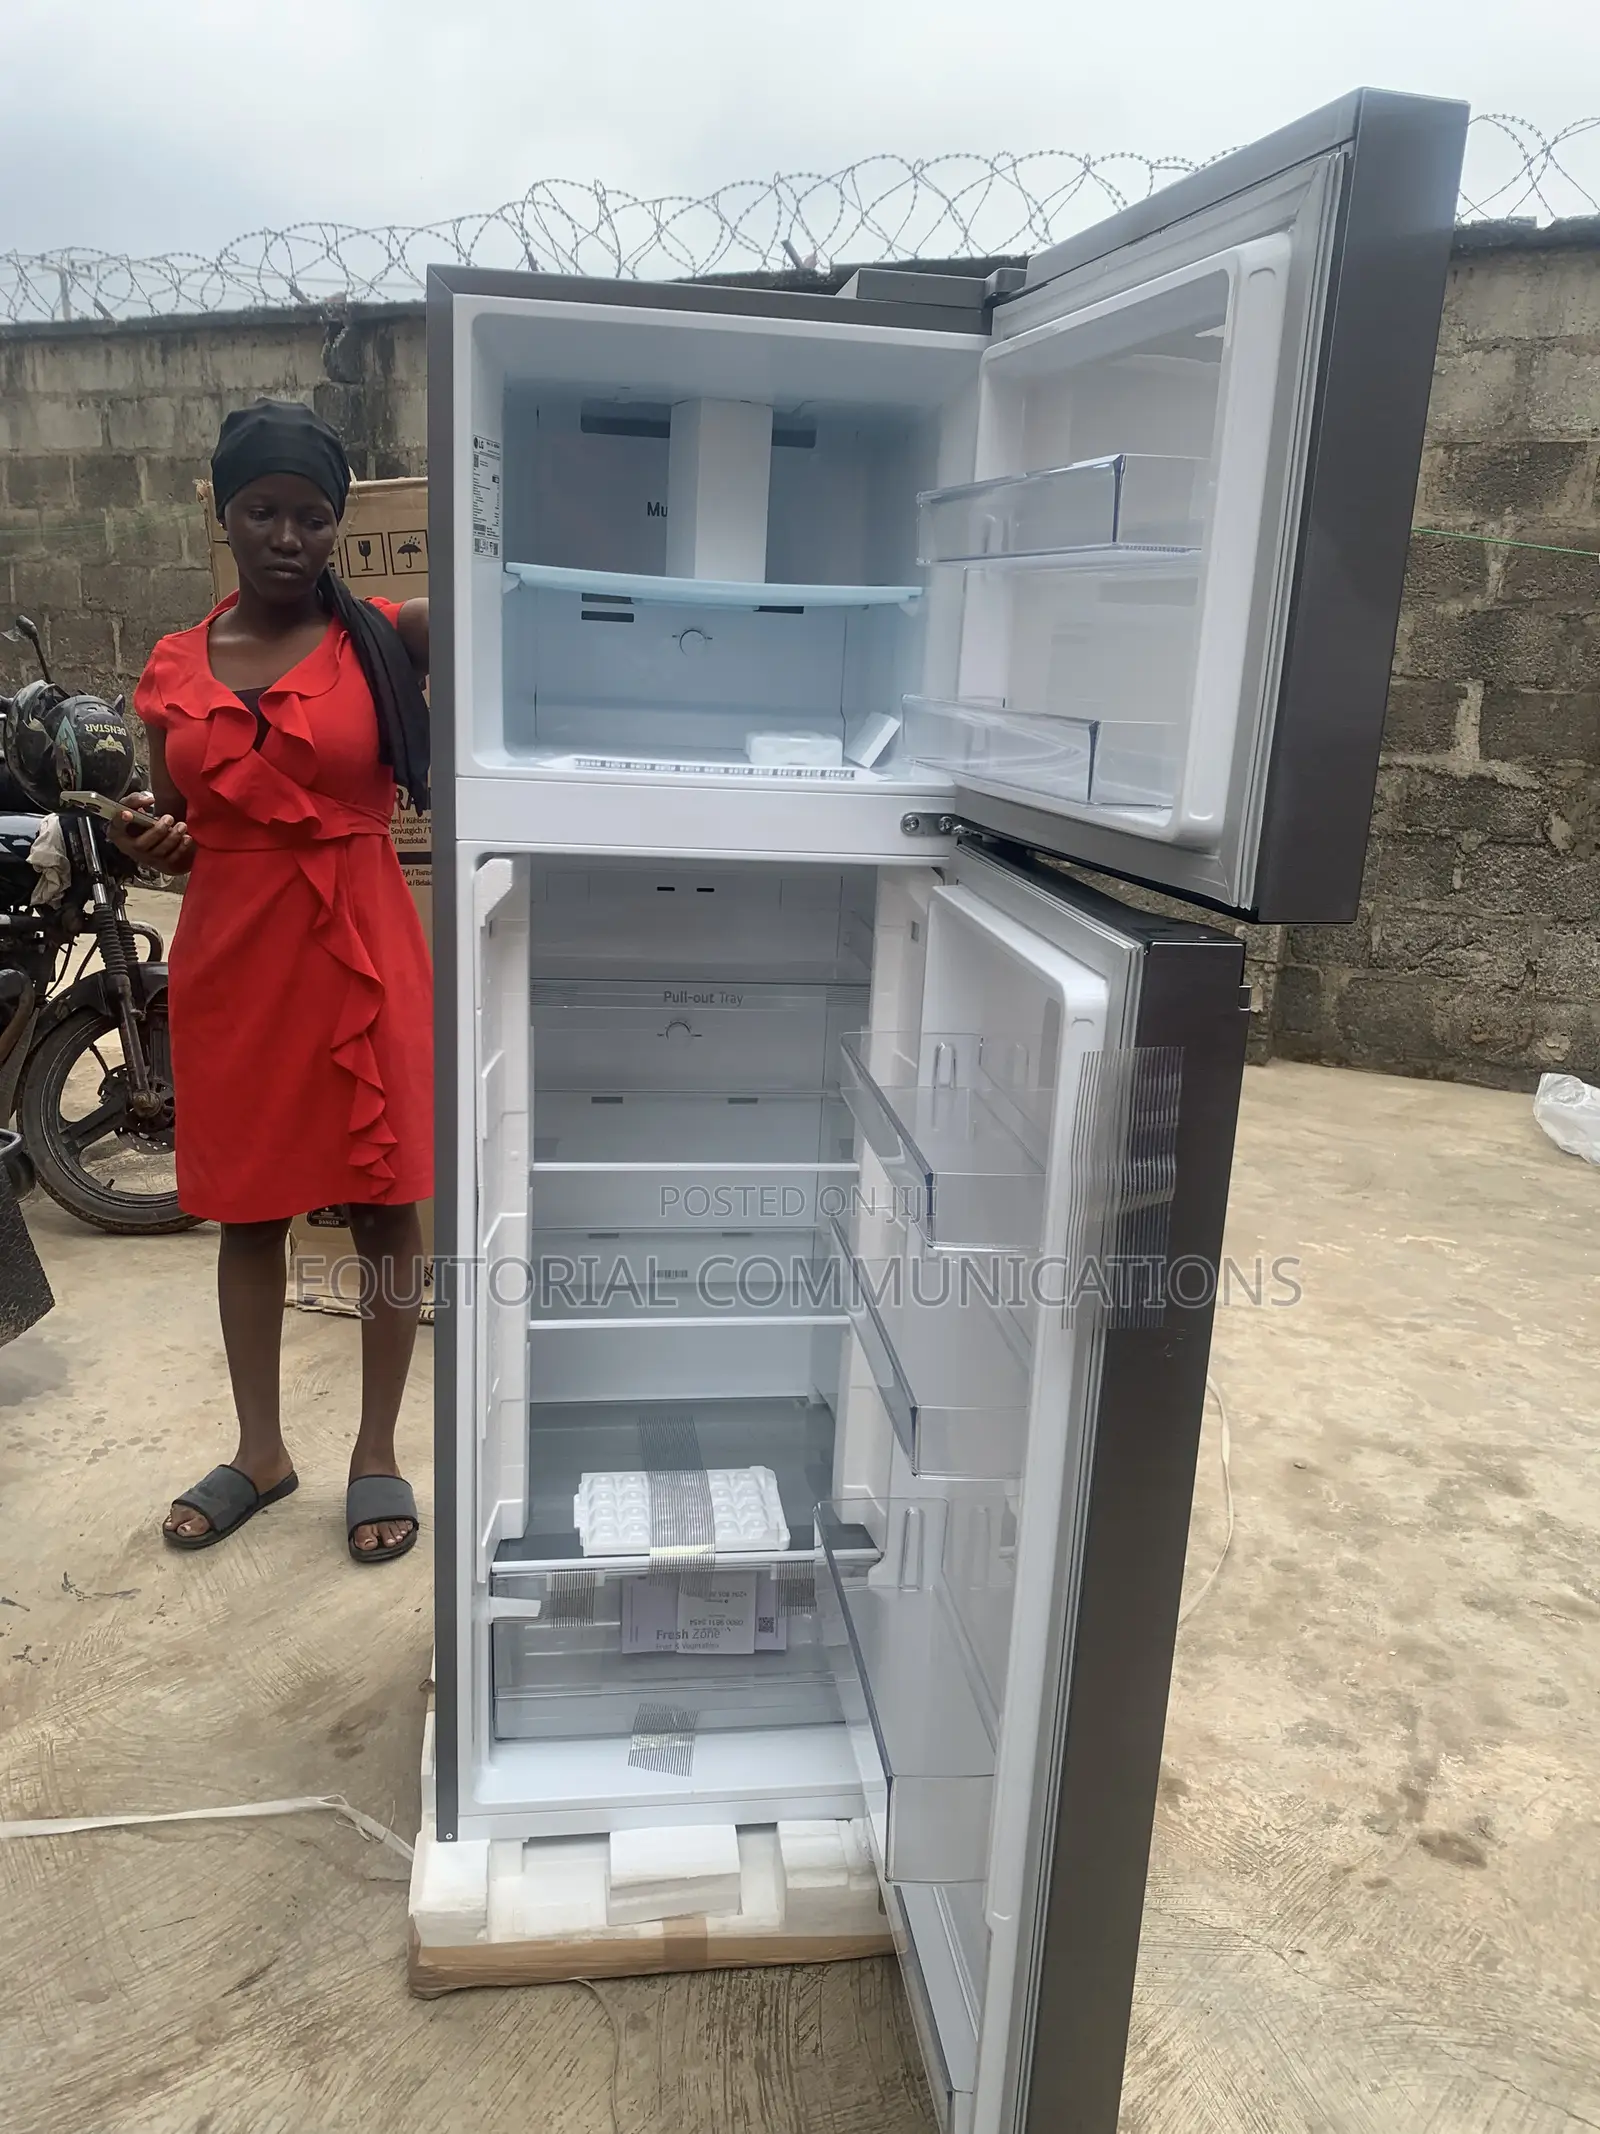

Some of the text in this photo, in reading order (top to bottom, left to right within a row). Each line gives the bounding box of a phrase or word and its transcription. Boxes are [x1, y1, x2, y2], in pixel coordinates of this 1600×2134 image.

[647, 501, 668, 518] Mu
[84, 724, 127, 736] DENSTAR
[664, 990, 744, 1007] Pull-out Tray
[656, 1629, 689, 1640] Fresh
[691, 1627, 721, 1640] Zone
